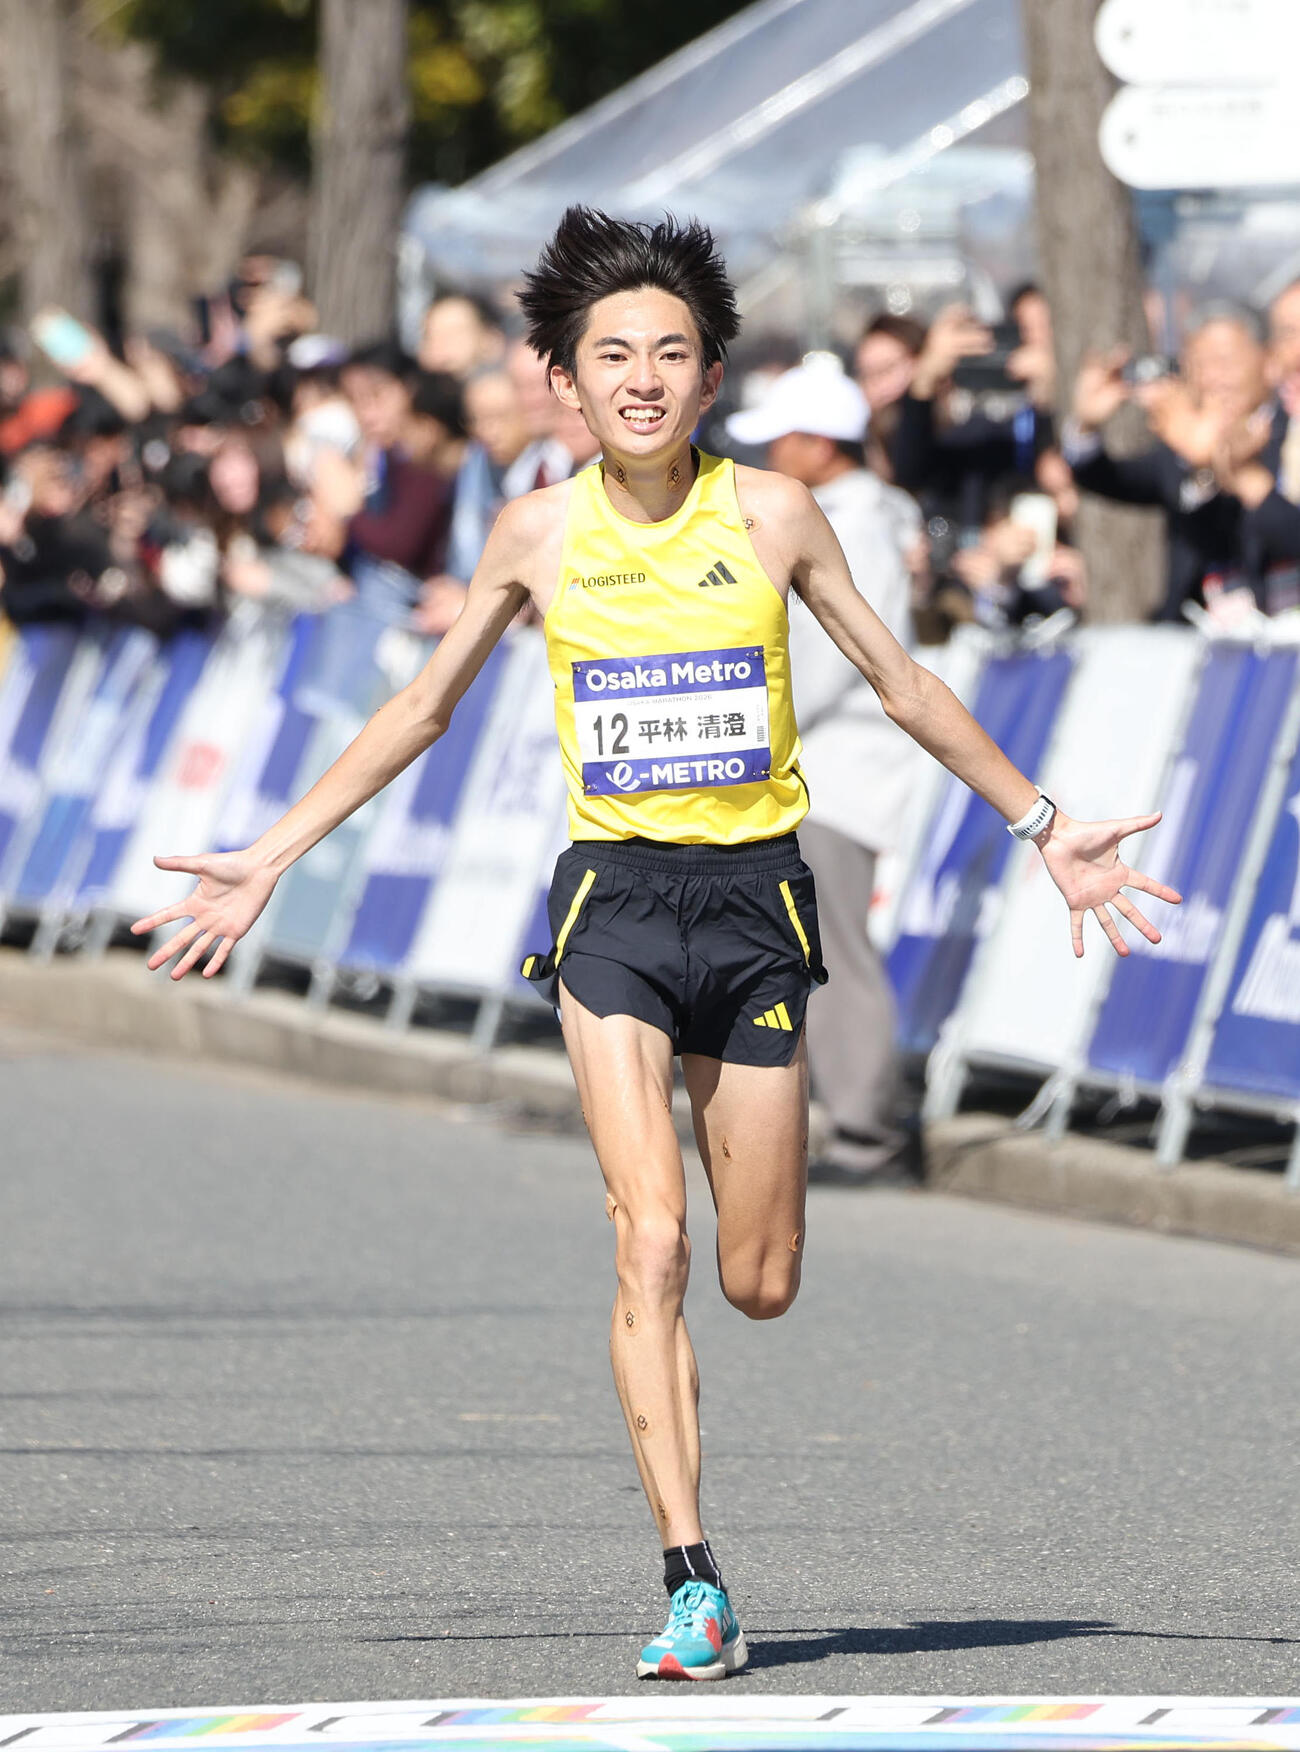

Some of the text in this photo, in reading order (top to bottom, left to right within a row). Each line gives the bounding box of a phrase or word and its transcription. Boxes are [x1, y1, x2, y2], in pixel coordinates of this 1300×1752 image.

[581, 572, 646, 588] LOGISTEED
[586, 660, 751, 692] Osaka Metro
[652, 696, 692, 705] MARATHON
[593, 712, 630, 756] 12
[638, 717, 688, 744] 平林
[697, 712, 747, 739] 清澄
